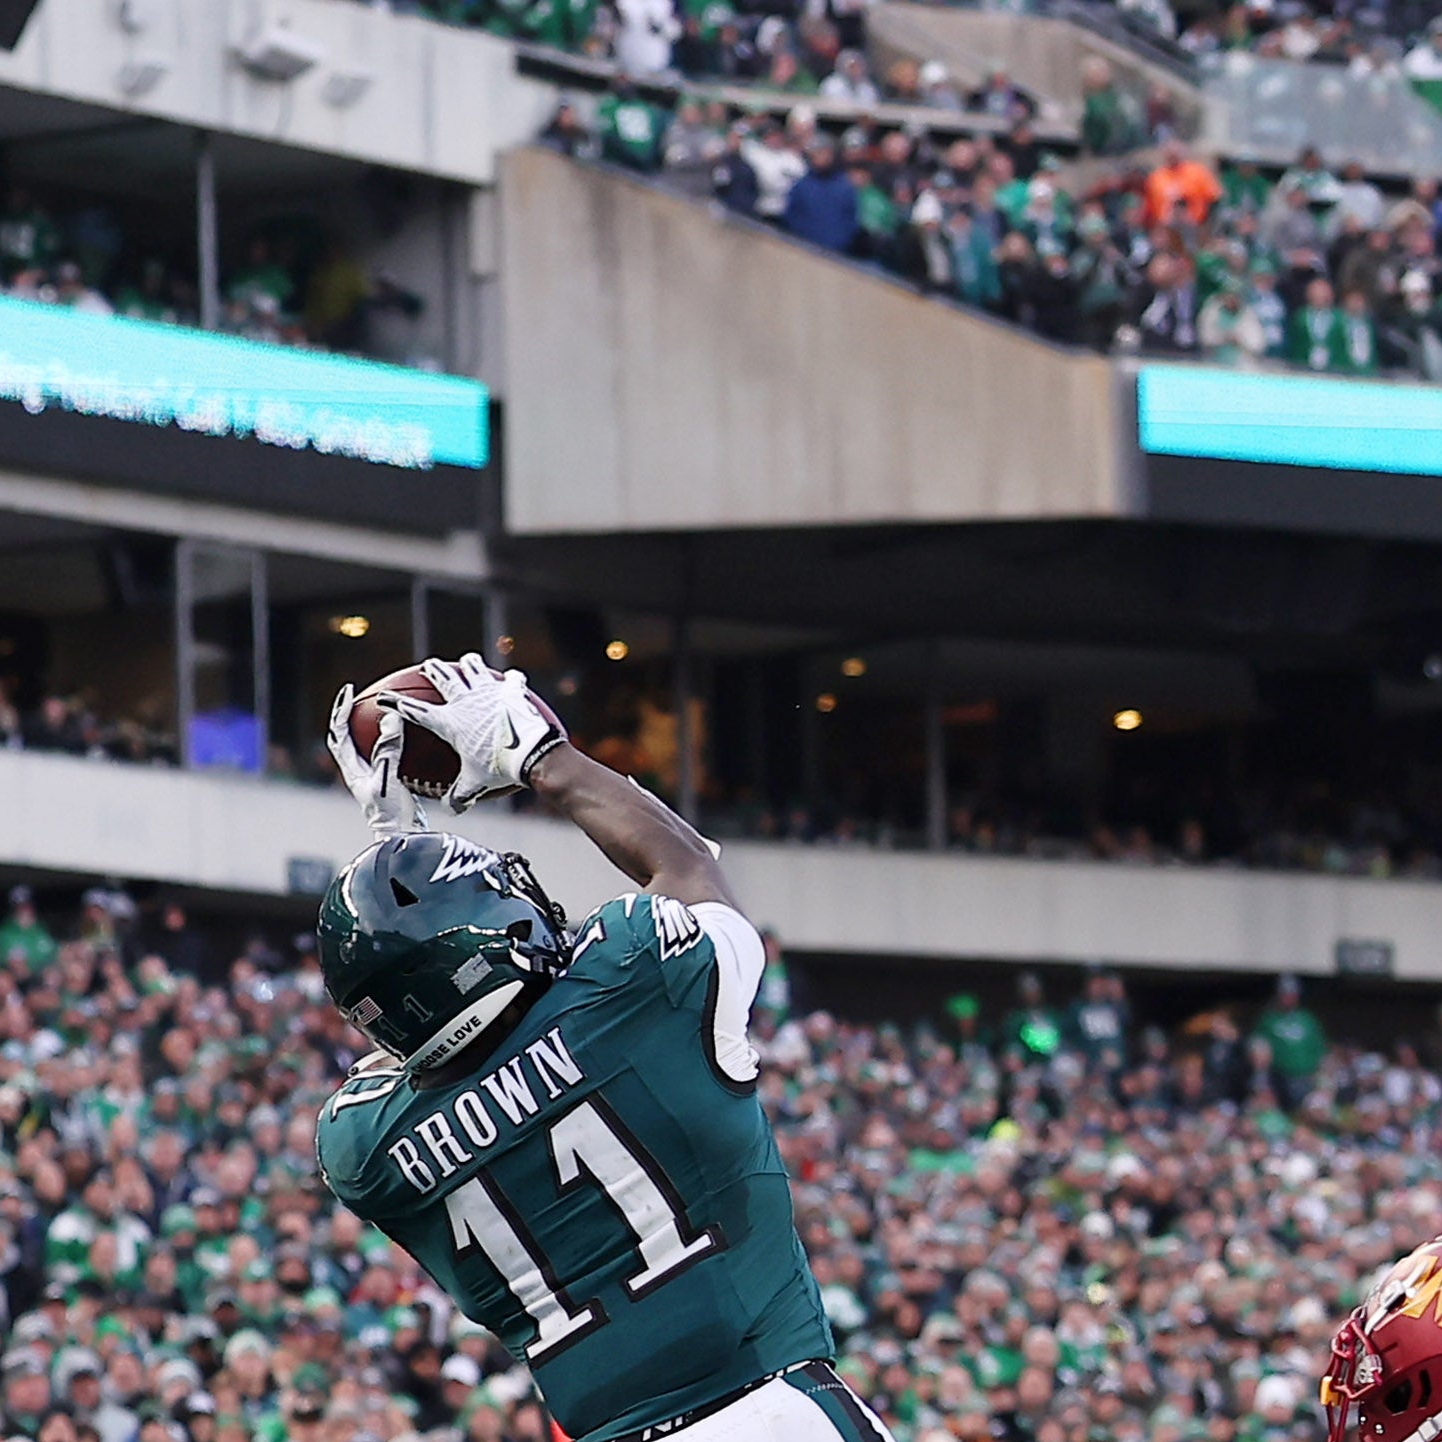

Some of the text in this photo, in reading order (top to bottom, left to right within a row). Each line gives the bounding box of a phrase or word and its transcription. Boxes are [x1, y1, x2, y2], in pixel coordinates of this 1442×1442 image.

[387, 1026, 586, 1196] BROWN
[446, 1014, 483, 1047] LOVE
[445, 1091, 725, 1369] 11
